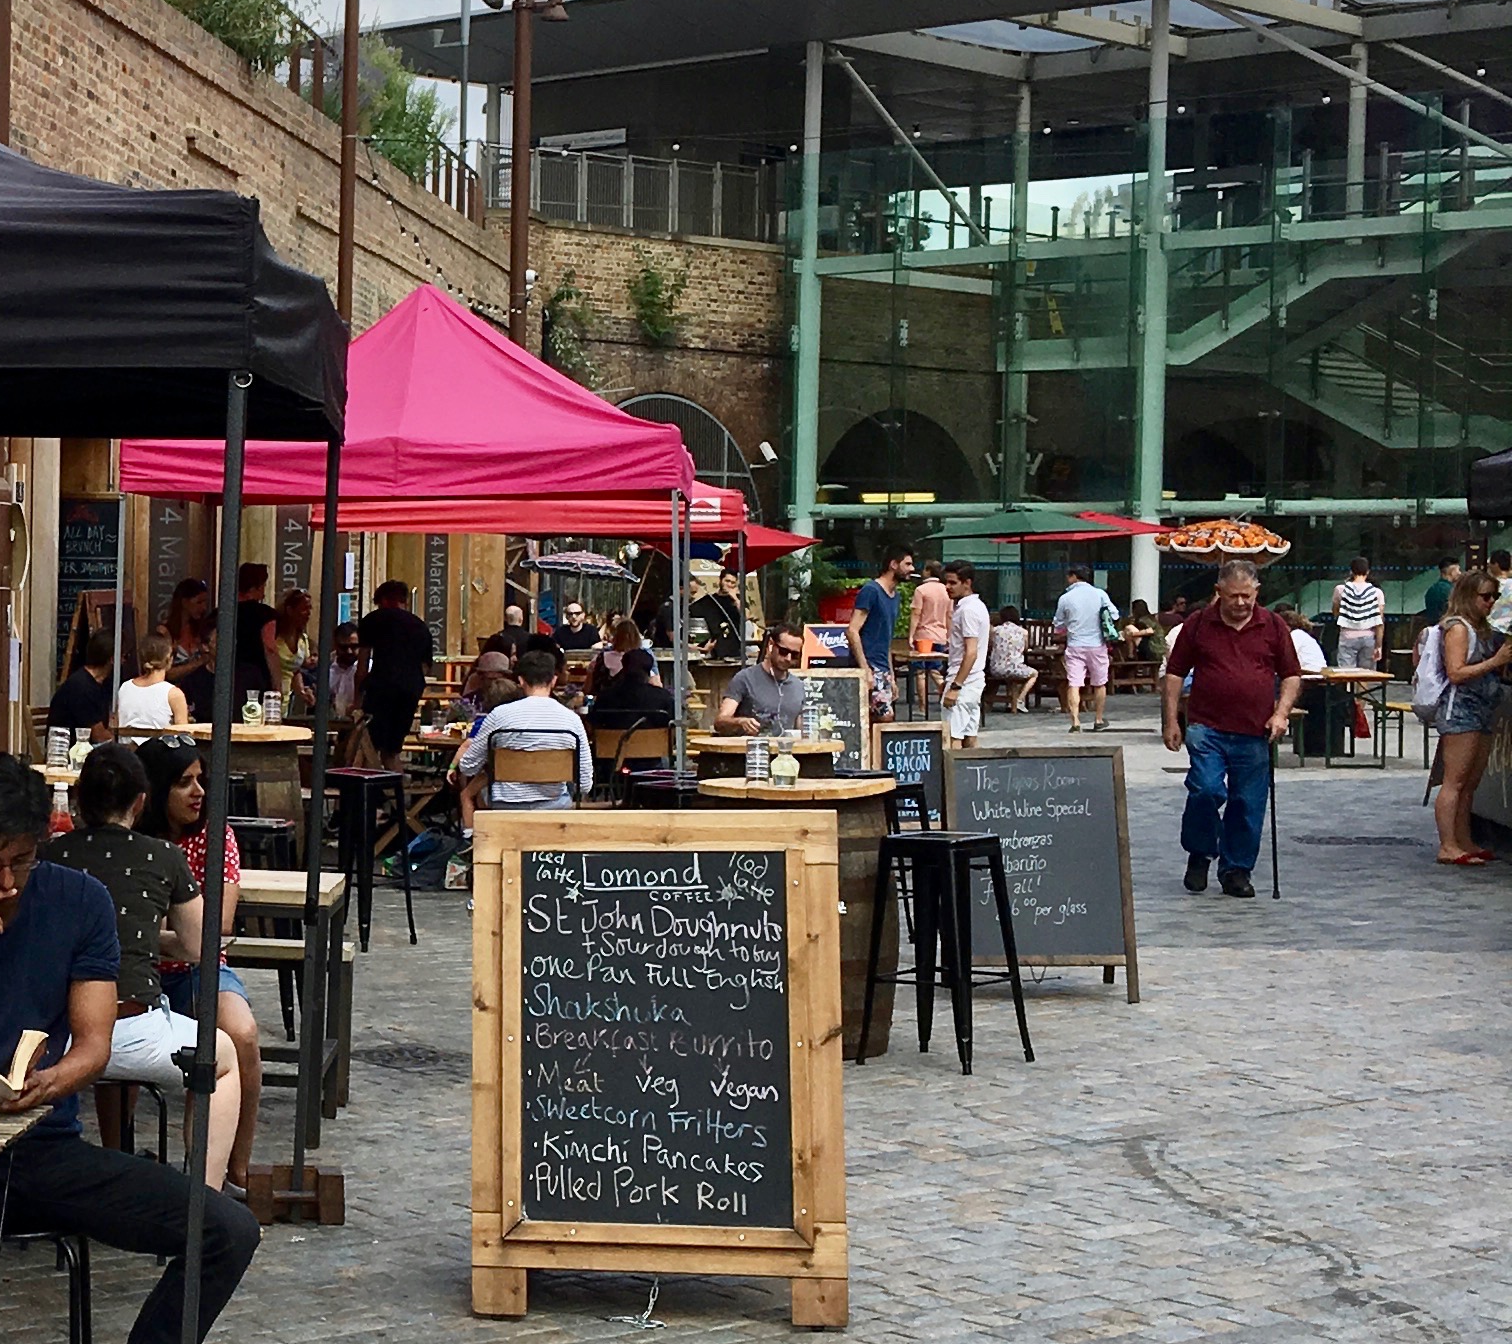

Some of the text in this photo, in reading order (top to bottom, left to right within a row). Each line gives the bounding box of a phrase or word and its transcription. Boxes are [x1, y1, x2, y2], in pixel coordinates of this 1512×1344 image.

[63, 525, 82, 539] ALL
[159, 506, 183, 525] 4
[283, 518, 304, 533] 4
[428, 536, 445, 657] 4 Market Yard
[886, 739, 931, 756] COFFEE
[966, 765, 1000, 794] The
[999, 763, 1039, 796] Tapas
[971, 797, 1092, 823] White Wine Special
[582, 852, 703, 887] Lomond
[648, 890, 714, 903] COFFEE
[1034, 906, 1052, 925] per
[1054, 897, 1088, 925] glass
[528, 893, 783, 953] St John Doughnuts
[729, 939, 750, 963] to
[753, 944, 781, 974] buy
[587, 953, 636, 986] Pan
[644, 962, 696, 989] Full
[705, 968, 784, 1011] English
[528, 982, 693, 1026] Shakshuka
[534, 1021, 774, 1061] Breakfast Burrito
[537, 1060, 606, 1095] Meat
[531, 1094, 768, 1148] Sweetcorn Fritters
[542, 1129, 765, 1183] Kimchi Pancakes
[535, 1161, 747, 1216] Pulled Pork Roll
